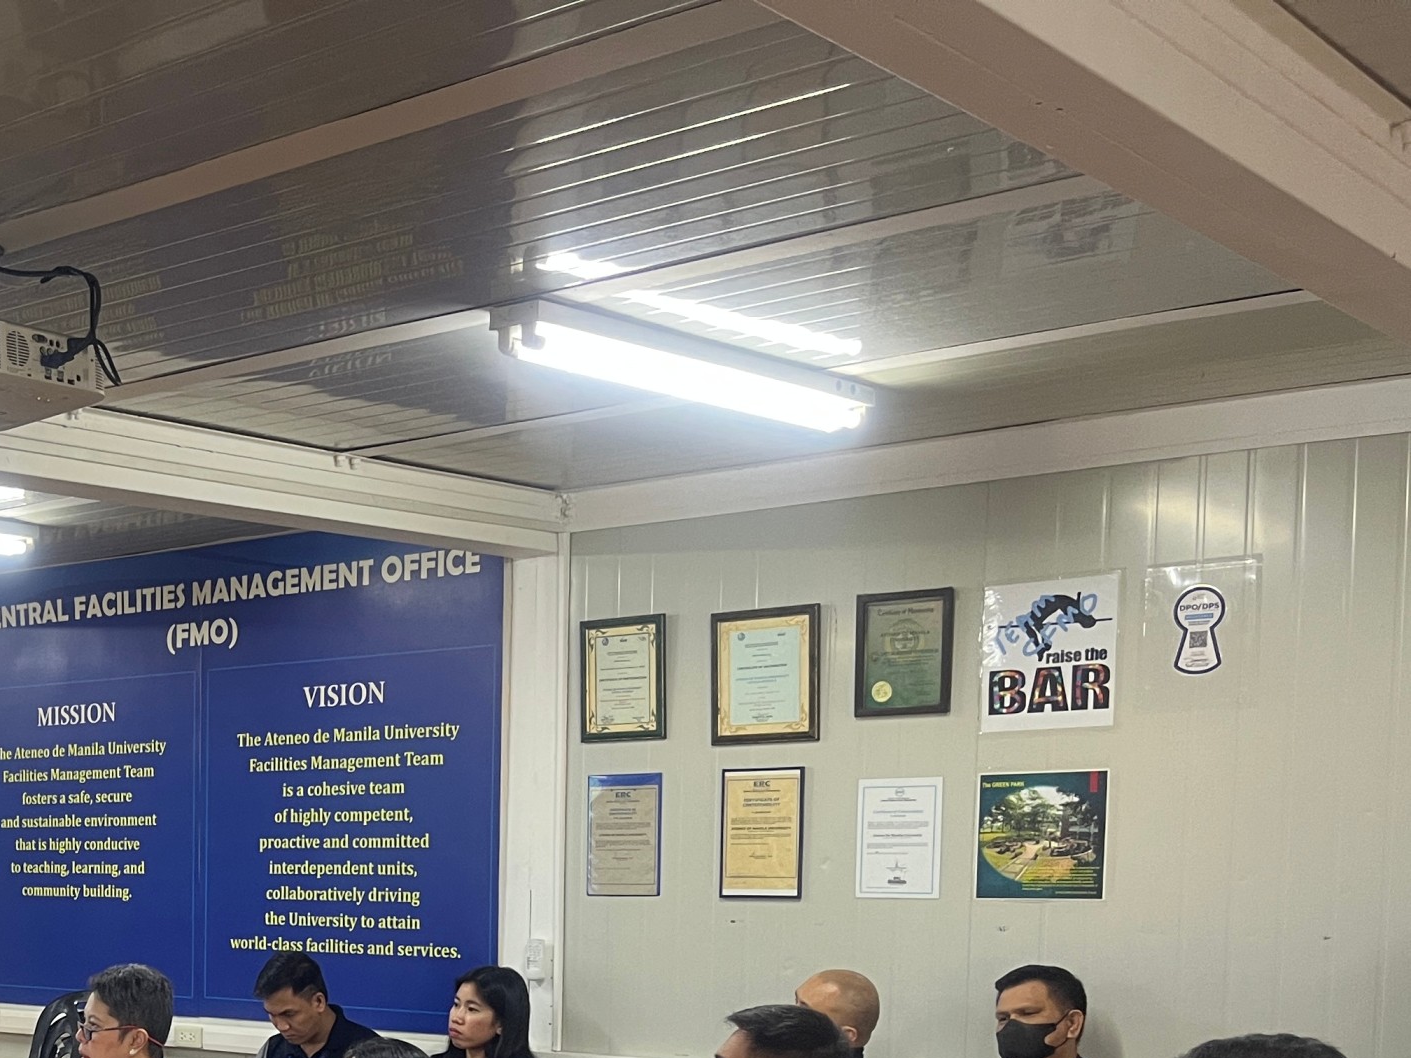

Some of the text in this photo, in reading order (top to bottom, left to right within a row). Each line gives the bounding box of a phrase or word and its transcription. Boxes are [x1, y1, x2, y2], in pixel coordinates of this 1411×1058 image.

[74, 583, 185, 620] FACILITIES
[191, 559, 373, 606] MANAGEMENT
[381, 549, 481, 584] OFFICE
[1179, 602, 1219, 612] DPO/DPS
[166, 617, 239, 655] (FMO)
[1046, 648, 1107, 664] raise the
[303, 681, 386, 708] VISION
[988, 664, 1110, 716] BAR
[37, 702, 116, 727] MISSION
[237, 722, 460, 747] The Ateneo de Manila University
[14, 747, 50, 760] Ateneo
[52, 745, 65, 757] de
[68, 742, 105, 756] Manila
[108, 739, 166, 755] University
[249, 752, 444, 773] Facilities Management Team
[3, 765, 154, 784] Facilities Management Team
[22, 790, 132, 805] fosters a safe, secure
[282, 781, 405, 797] is a cohesive team
[1, 814, 157, 829] and sustainable environment
[275, 808, 413, 826] of highly competent,
[15, 837, 140, 854] that is highly conducive
[259, 833, 429, 852] proactive and committed
[11, 861, 145, 877] to teaching, learning, and
[269, 860, 418, 879] interdependent units,
[22, 884, 132, 901] community building.
[266, 886, 420, 907] collaboratively driving
[265, 911, 420, 932] the University to attain
[230, 936, 461, 959] world-class facilities and services.
